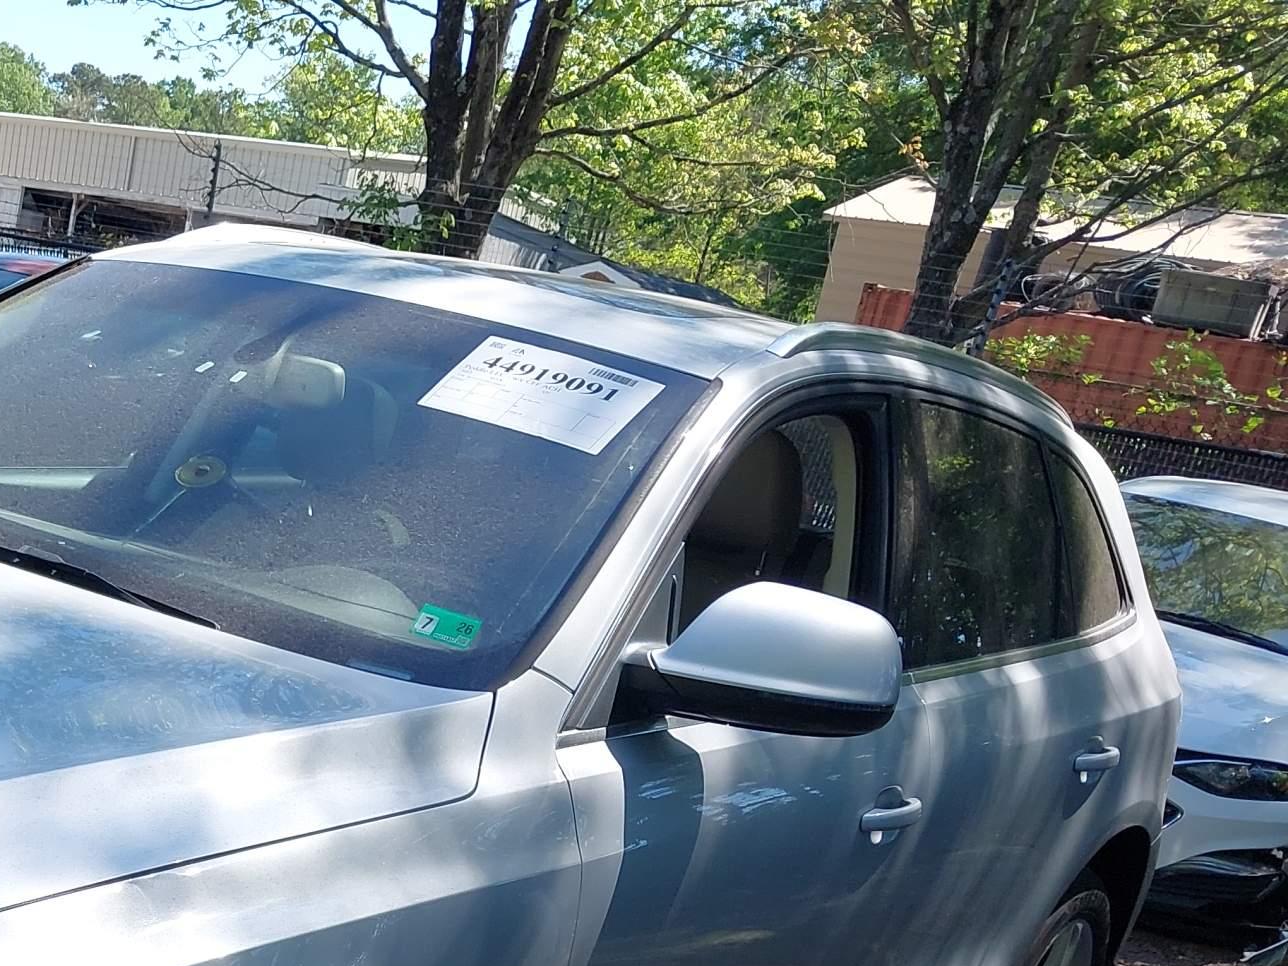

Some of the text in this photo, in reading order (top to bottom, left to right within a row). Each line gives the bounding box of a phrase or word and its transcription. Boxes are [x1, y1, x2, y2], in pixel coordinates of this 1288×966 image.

[483, 357, 619, 402] 44919091
[421, 616, 474, 635] 7 26
